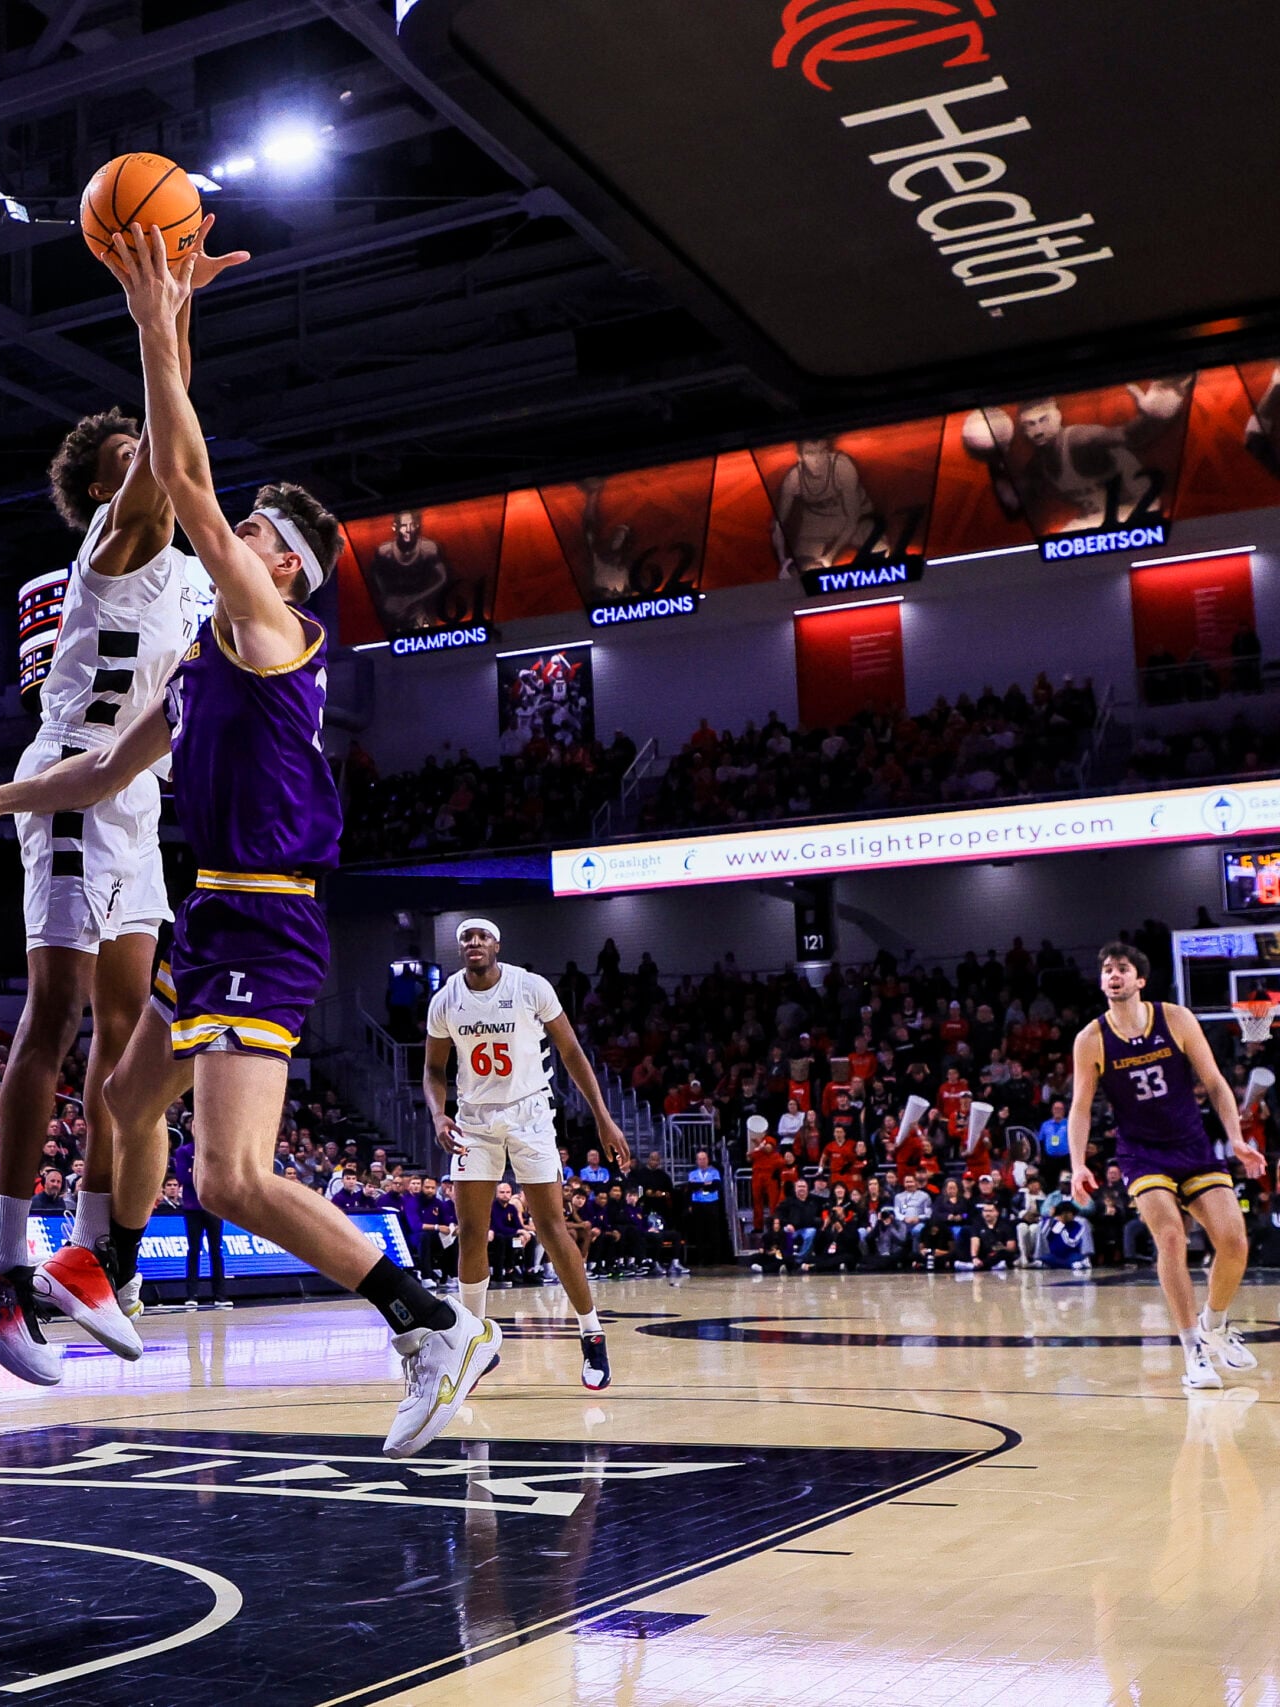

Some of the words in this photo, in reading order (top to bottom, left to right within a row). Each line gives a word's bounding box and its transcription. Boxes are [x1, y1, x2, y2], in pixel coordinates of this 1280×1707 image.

[839, 75, 1114, 309] Health
[1044, 526, 1164, 559] ROBERTSON
[819, 564, 906, 592] TWYMAN
[592, 596, 694, 626] CHAMPIONS
[393, 627, 487, 655] CHAMPIONS
[726, 817, 1114, 867] www.GaslightProperty.com
[609, 854, 662, 871] Gaslight
[803, 934, 824, 950] 121
[225, 970, 253, 1003] L
[458, 1021, 516, 1036] CINCINNATI
[471, 1042, 512, 1077] 65
[1113, 1048, 1173, 1070] LIPSCOMB
[1129, 1065, 1169, 1101] 33
